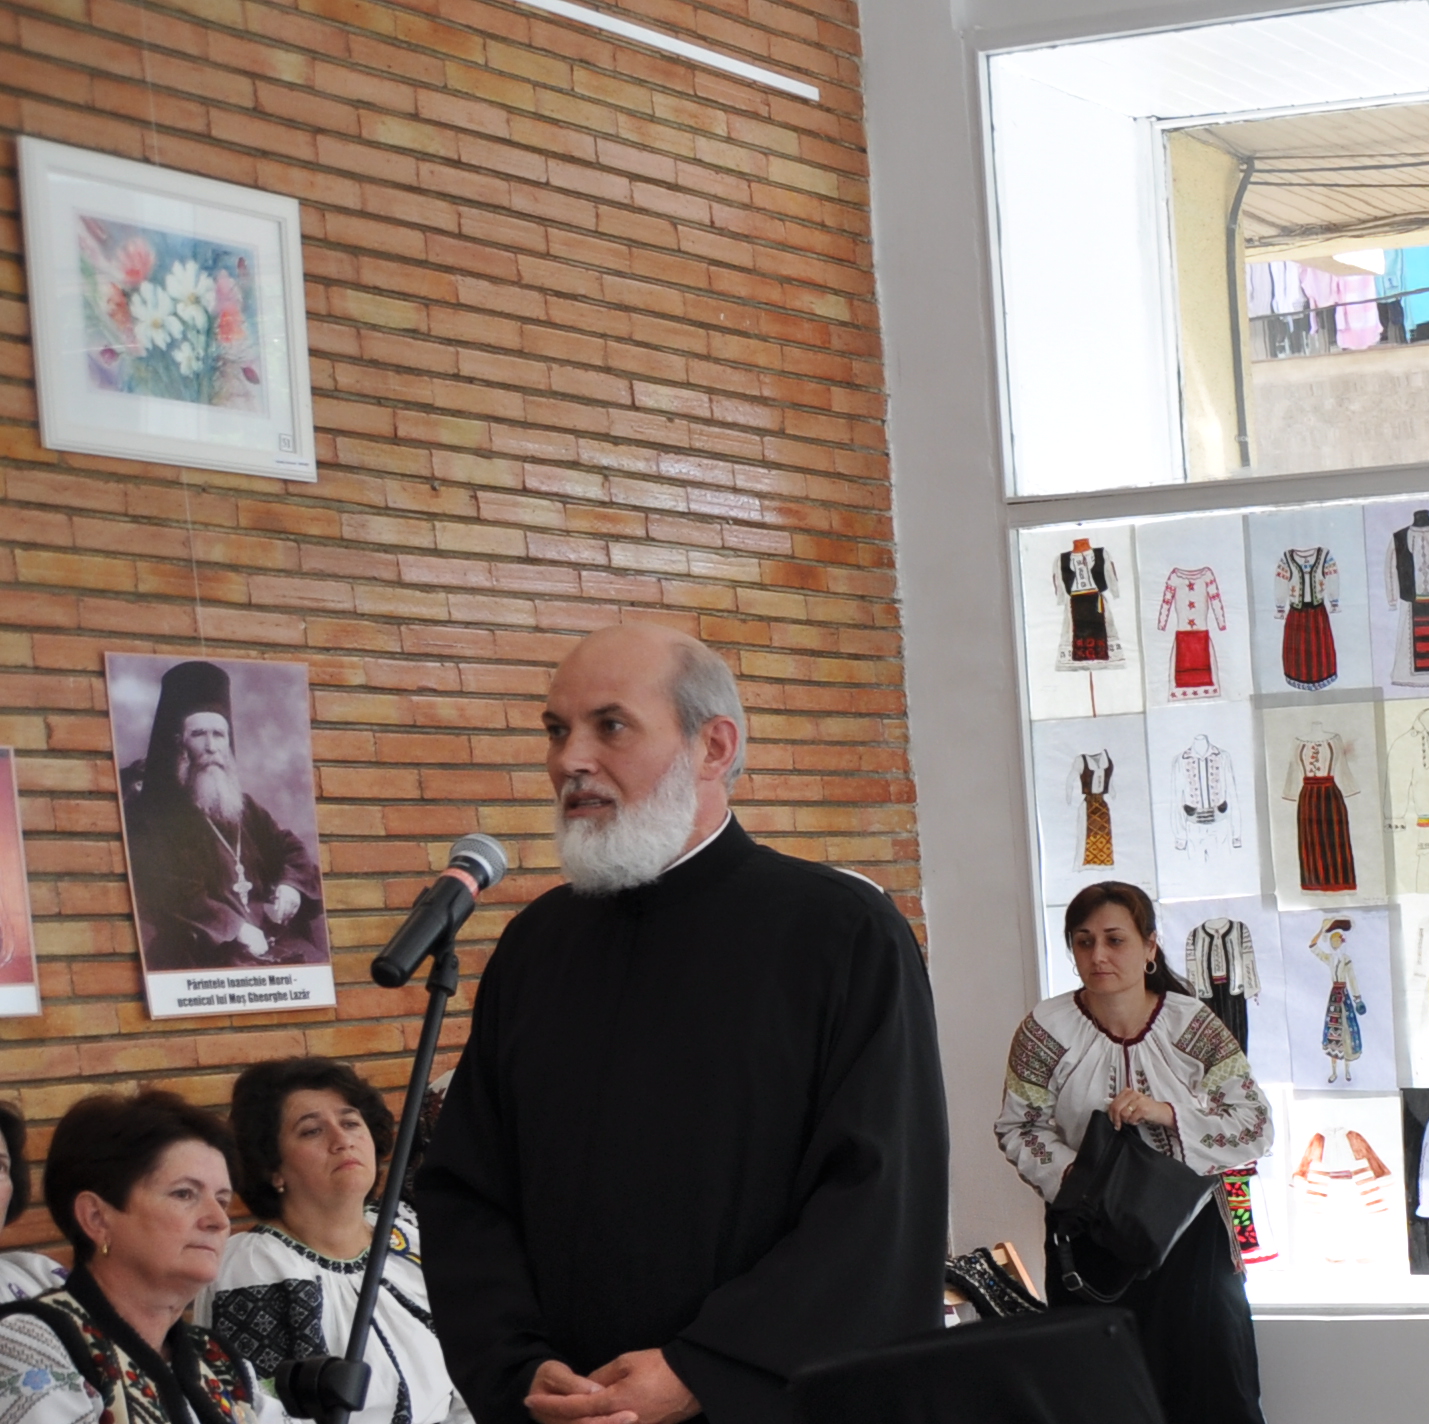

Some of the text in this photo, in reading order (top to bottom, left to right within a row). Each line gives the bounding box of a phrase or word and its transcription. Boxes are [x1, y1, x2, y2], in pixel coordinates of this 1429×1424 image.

[177, 995, 214, 1008] ucenicul
[216, 993, 228, 1005] lui
[247, 991, 288, 1003] Gheorghe
